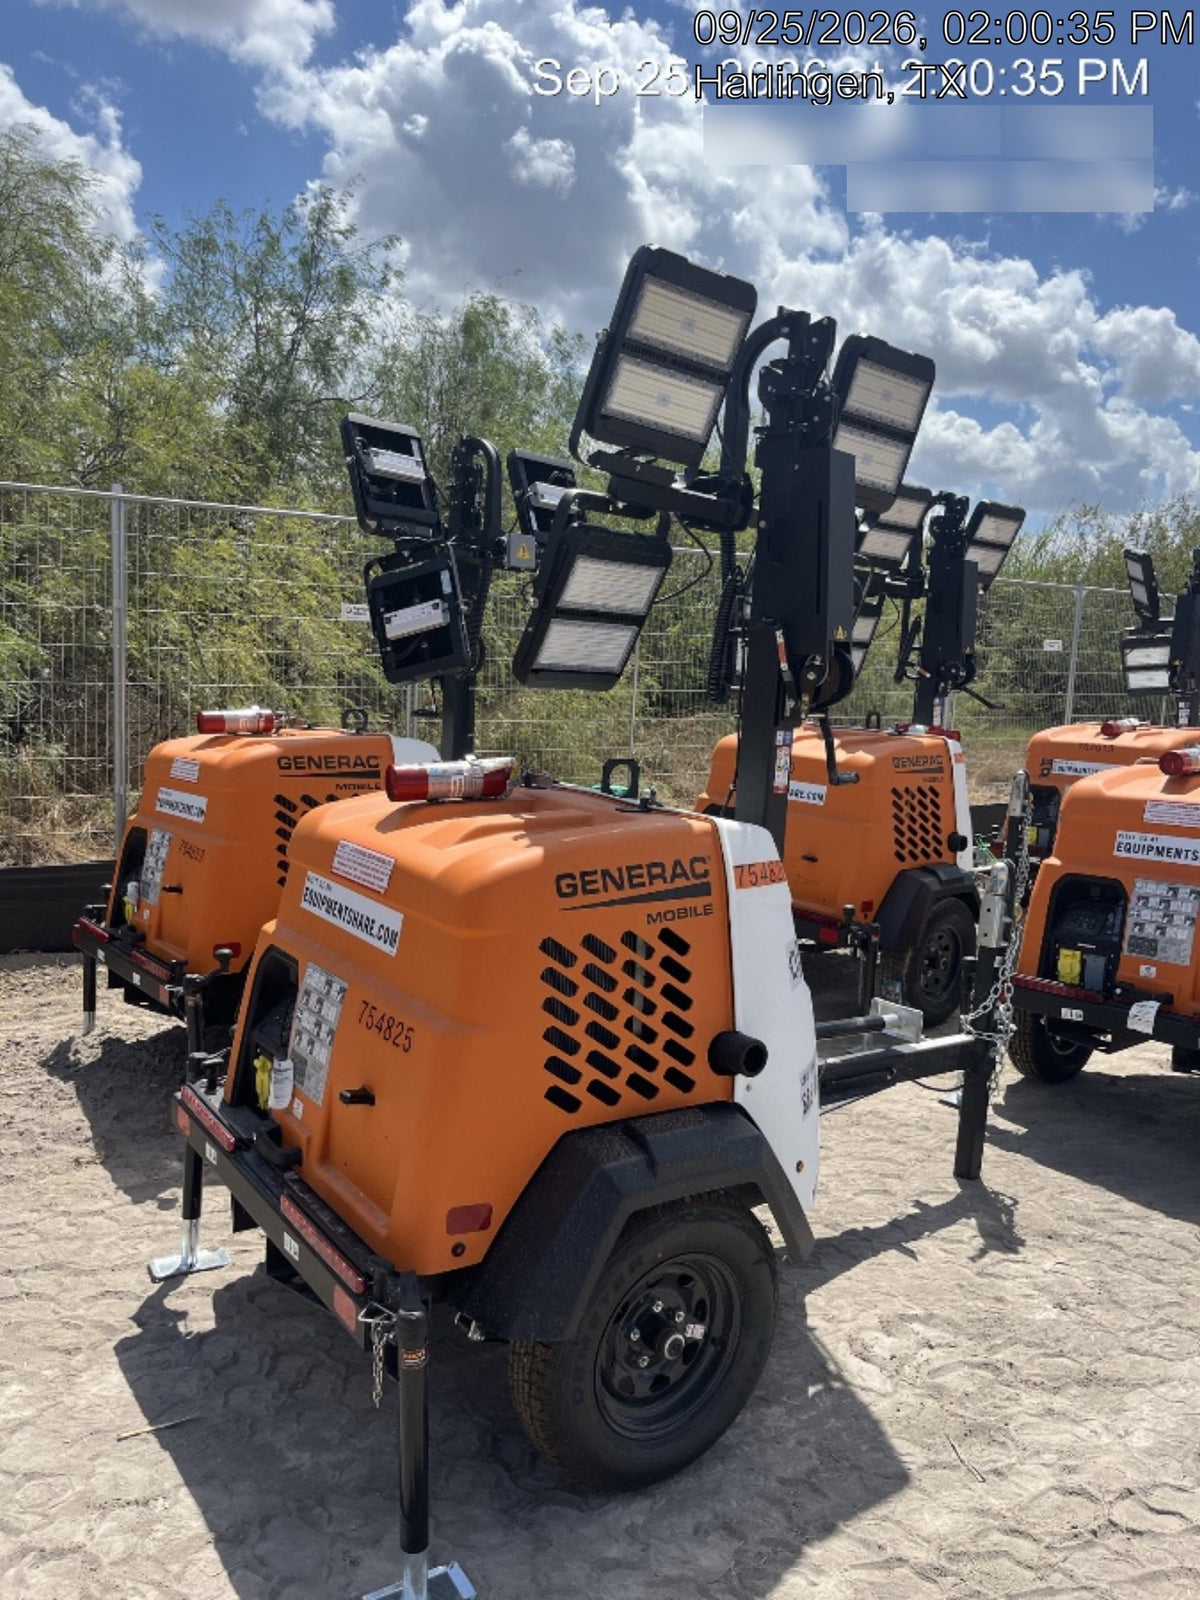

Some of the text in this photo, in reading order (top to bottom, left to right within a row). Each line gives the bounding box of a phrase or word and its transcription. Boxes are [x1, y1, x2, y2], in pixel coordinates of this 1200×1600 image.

[277, 755, 379, 770] GENERAC
[1116, 841, 1200, 861] EQUIPMENTS
[555, 856, 710, 899] GENERAC
[303, 886, 399, 950] EQUIPMENTSHARE.COM
[646, 903, 714, 925] MOBILE
[357, 999, 415, 1053] 754825
